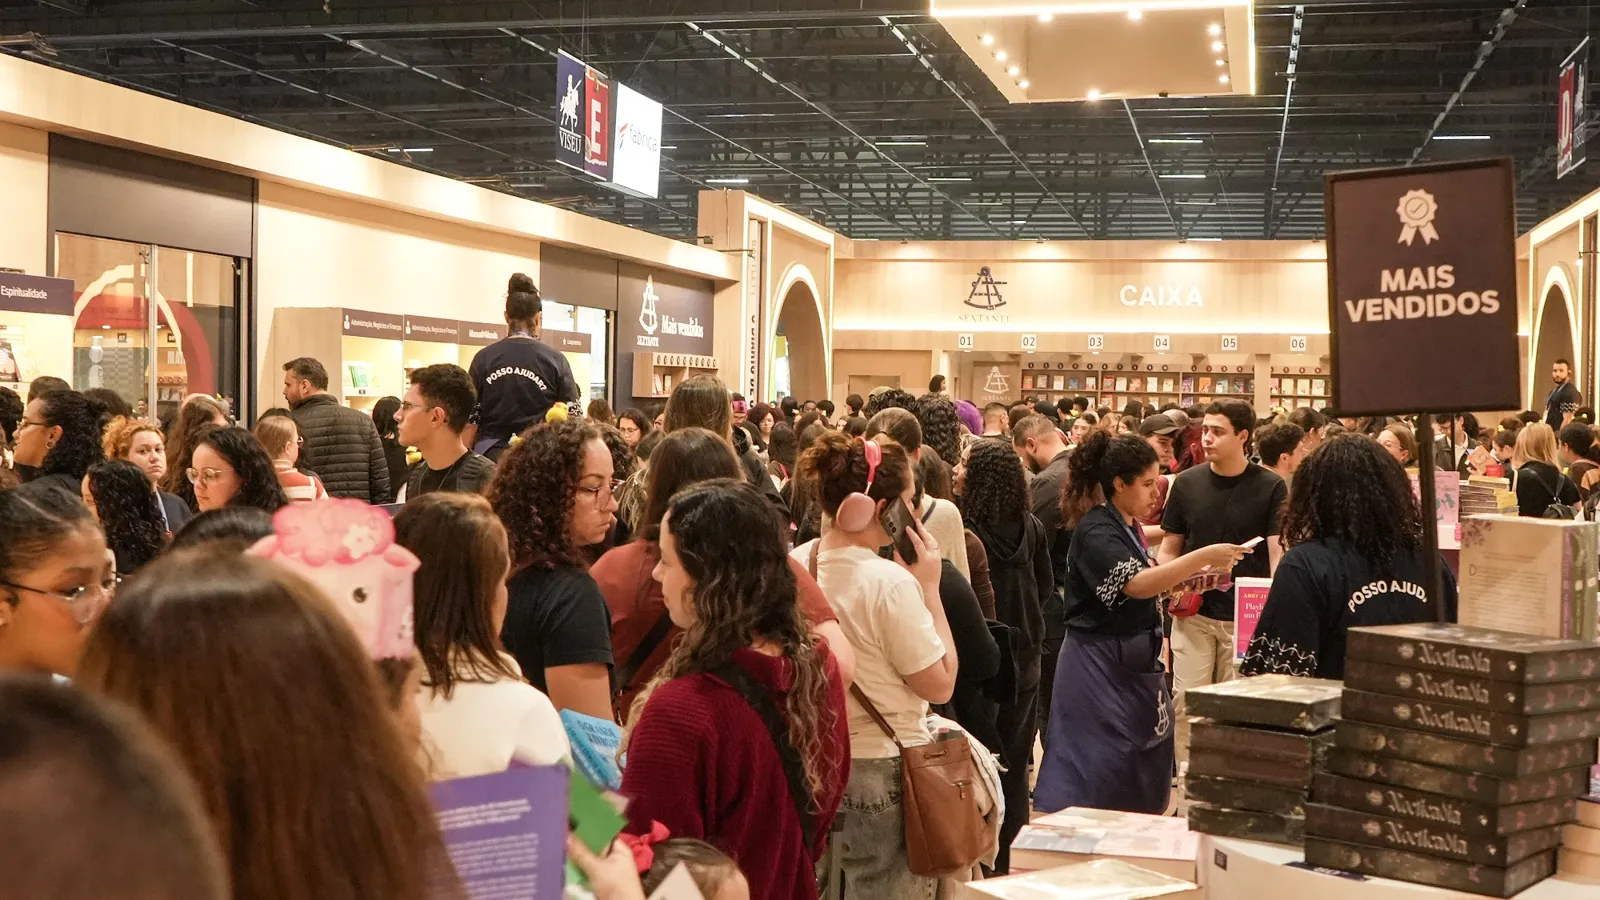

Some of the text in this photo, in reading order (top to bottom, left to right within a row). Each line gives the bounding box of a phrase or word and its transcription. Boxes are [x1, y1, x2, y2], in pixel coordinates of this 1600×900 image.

[591, 98, 601, 155] E
[559, 131, 582, 154] VISEU
[1380, 264, 1456, 292] MAIS
[1, 285, 48, 299] Espiritualidade
[1119, 285, 1204, 307] CAIXA
[1344, 289, 1501, 323] VENDIDOS
[661, 314, 704, 338] Mais vendidos
[637, 335, 660, 347] SEXTANTE
[960, 336, 971, 345] 01
[1023, 337, 1035, 346] 02
[1089, 337, 1102, 347] 03
[1155, 338, 1168, 348] 04
[1223, 338, 1236, 348] 05
[1291, 338, 1304, 349] 06
[486, 366, 548, 391] POSSO AJUDAR?
[1348, 580, 1387, 613] POSSO
[1245, 602, 1264, 613] Playli
